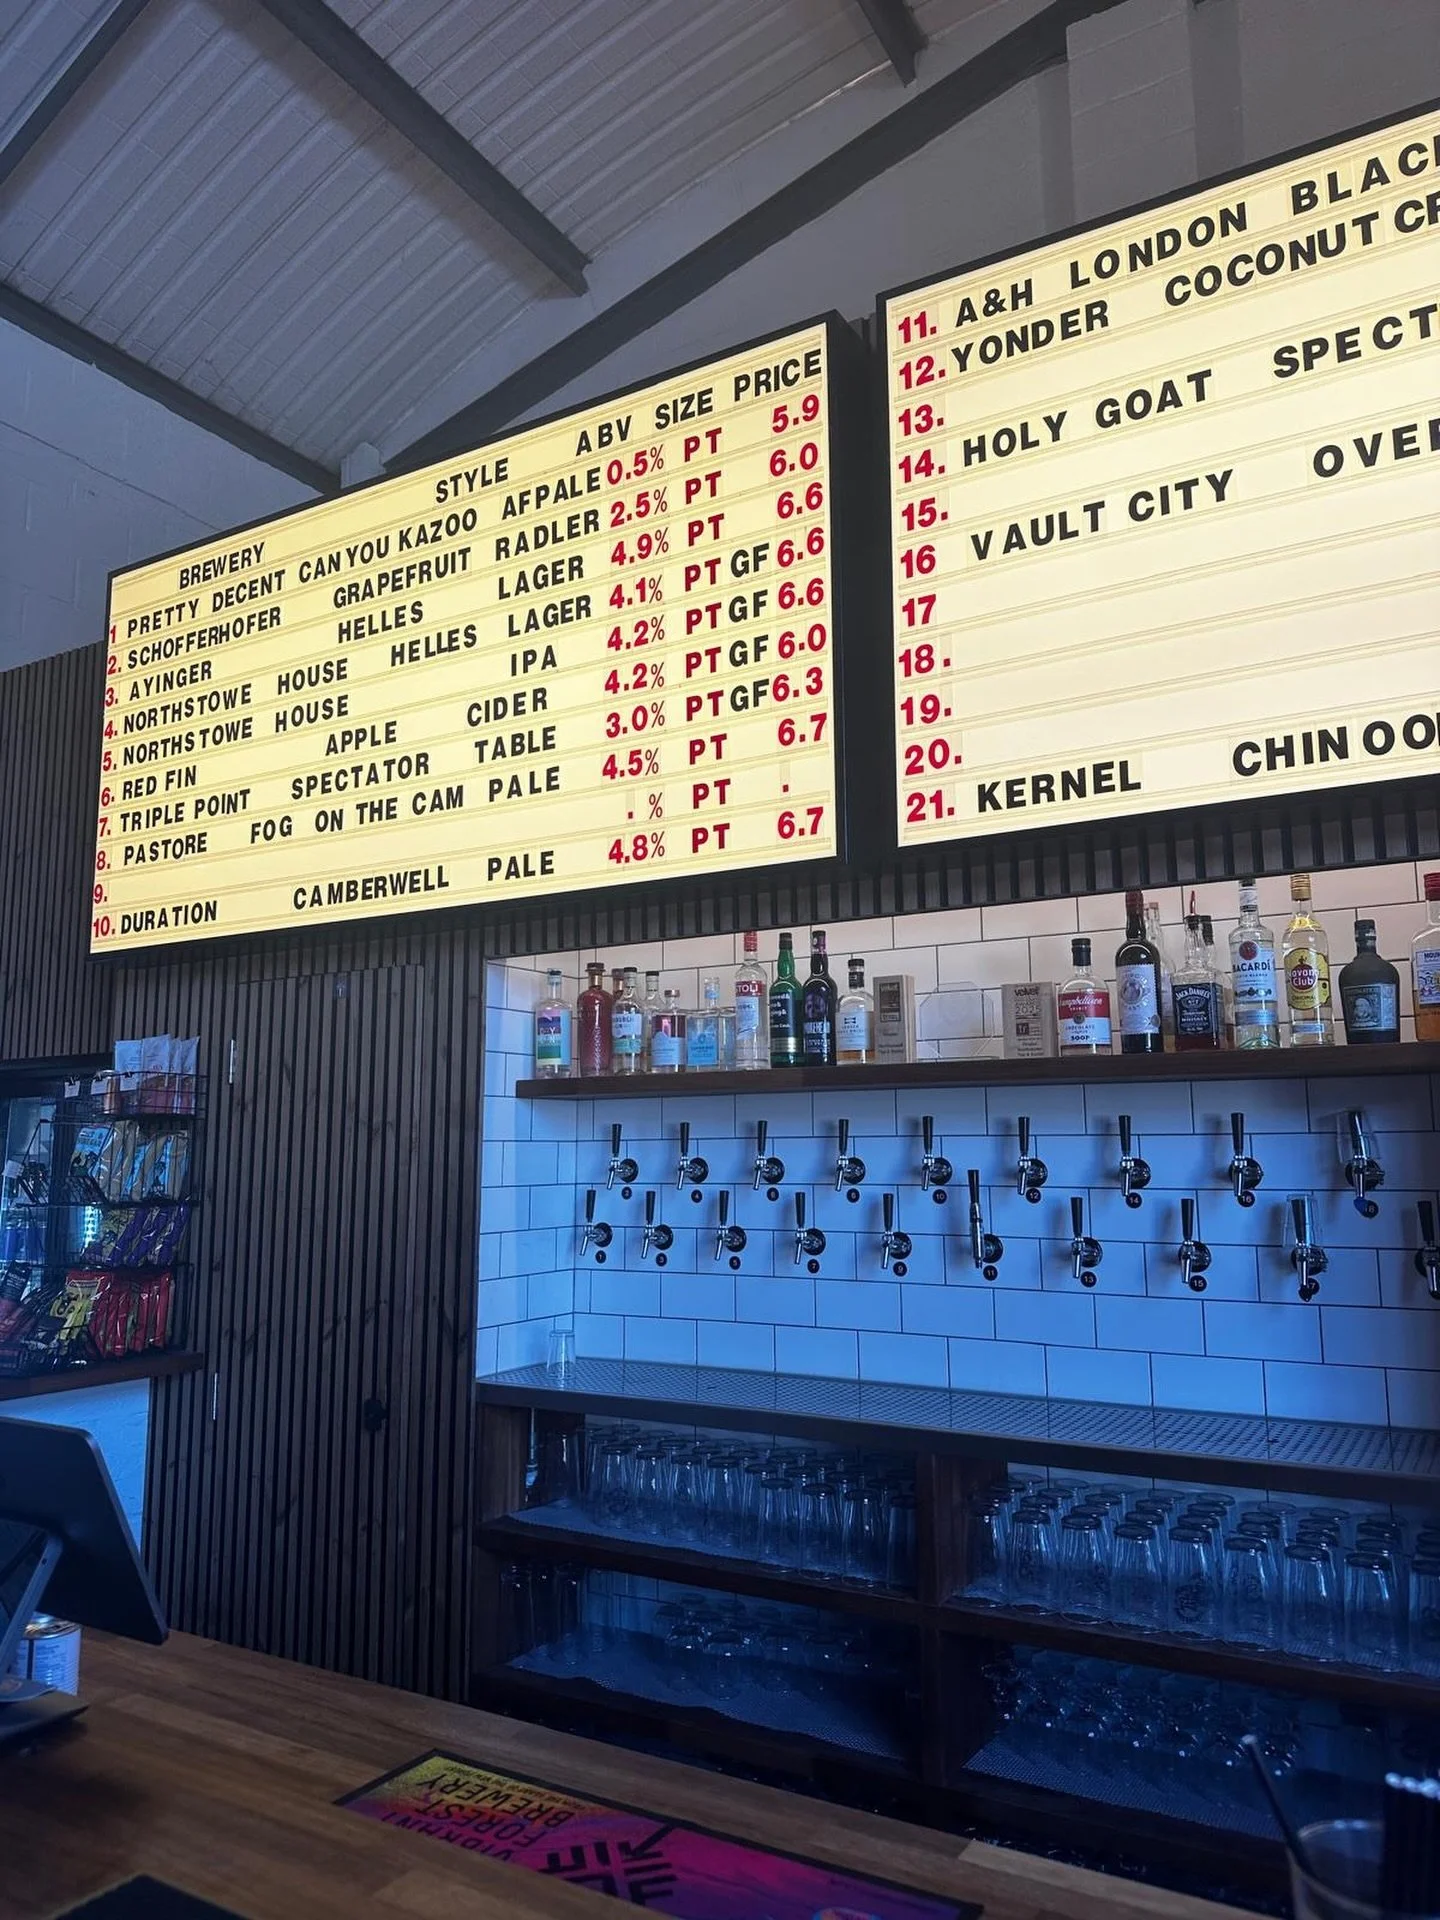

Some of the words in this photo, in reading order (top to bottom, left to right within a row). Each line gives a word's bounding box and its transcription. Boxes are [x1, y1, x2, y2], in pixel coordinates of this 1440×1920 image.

[897, 310, 937, 344] 11.
[955, 278, 1033, 328] A&H
[1069, 201, 1248, 290] LONDON
[1290, 134, 1440, 216] BLAC
[898, 355, 946, 390] 12.
[950, 299, 1109, 373] YONDER
[1164, 210, 1380, 307] COCONUT
[898, 448, 946, 484] 14.
[963, 410, 1068, 468] HOLY
[1095, 368, 1212, 429] GOAT
[1273, 303, 1440, 379] SPECT
[898, 403, 944, 437] 13.
[127, 598, 200, 639] PRETTY
[212, 568, 286, 613] DECENT
[398, 508, 478, 552] KAZOO
[606, 444, 664, 486] 0.5%
[684, 426, 722, 463] PT
[772, 394, 820, 434] 5.9
[179, 541, 265, 590] BREWERY
[435, 457, 509, 504] STYLE
[575, 414, 632, 457] ABV
[654, 387, 713, 430] SIZE
[734, 348, 822, 403] PRICE
[900, 544, 936, 579] 16
[970, 500, 1106, 561] VAULT
[1128, 468, 1233, 522] CITY
[901, 496, 949, 532] 15.
[105, 686, 120, 709] 3.
[129, 660, 212, 702] AYINGER
[338, 600, 424, 644] HELLES
[498, 555, 584, 601] LAGER
[610, 527, 669, 566] 4.9%
[687, 512, 725, 547] PT
[776, 481, 824, 520] 6.6
[107, 655, 123, 676] 2.
[127, 606, 281, 670] SCHOFFERHOFER
[333, 546, 471, 609] GRAPEFRUIT
[495, 508, 600, 562] RADLER
[610, 486, 668, 528] 2.5%
[685, 470, 722, 505] PT
[769, 442, 819, 477] 6.0
[901, 593, 937, 628] 17
[102, 750, 118, 773] 5.
[123, 716, 253, 767] NORTHSTOWE
[275, 694, 349, 733] HOUSE
[511, 644, 557, 677] IPA
[607, 614, 665, 652] 4.2%
[686, 601, 722, 636] PT
[728, 589, 768, 623] GF
[777, 577, 825, 610] 6.6
[104, 720, 118, 740] 4.
[123, 683, 252, 735] NORTHSTOWE
[277, 657, 348, 696] HOUSE
[390, 624, 477, 667] HELLES
[508, 594, 591, 638] LAGER
[609, 575, 663, 609] 4.1%
[684, 557, 722, 593] PT
[730, 542, 770, 578] GF
[776, 526, 825, 568] 6.6
[898, 643, 951, 678] 18.
[99, 816, 112, 838] 7.
[120, 801, 185, 833] TRIPLE
[194, 788, 251, 820] POINT
[291, 752, 429, 800] SPECTATOR
[474, 725, 556, 764] TABLE
[605, 700, 665, 739] 3.0%
[686, 689, 724, 722] PT
[730, 678, 770, 712] GF
[772, 666, 823, 703] 6.3
[100, 786, 116, 808] 6.
[122, 775, 157, 801] RED
[165, 764, 197, 792] FIN
[325, 720, 397, 757] APPLE
[467, 687, 548, 727] CIDER
[604, 662, 665, 695] 4.2%
[685, 646, 722, 679] PT
[729, 634, 769, 668] GF
[777, 623, 827, 660] 6.0
[900, 693, 952, 726] 19.
[904, 738, 962, 776] 20.
[96, 850, 112, 872] 8.
[123, 831, 208, 866] PASTORE
[250, 815, 293, 844] FOG
[314, 808, 344, 833] ON
[355, 796, 398, 825] THE
[412, 784, 464, 816] CAM
[488, 765, 560, 803] PALE
[602, 747, 659, 780] 4.5%
[689, 732, 728, 766] PT
[777, 712, 828, 747] 6.7
[906, 789, 955, 823] 21.
[977, 760, 1142, 813] KERNEL
[1232, 712, 1440, 777] CHINOO
[93, 915, 116, 938] 10.
[120, 900, 218, 935] DURATION
[293, 865, 450, 910] CAMBERWELL
[487, 850, 555, 882] PALE
[608, 831, 665, 865] 4.8%
[691, 822, 731, 854] PT
[777, 806, 824, 840] 6.7
[95, 883, 109, 905] 9.
[692, 778, 731, 810] PT
[736, 984, 758, 994] TOLI
[1029, 1192, 1039, 1200] 12
[1129, 1197, 1139, 1205] 14
[1242, 1196, 1252, 1204] 16
[987, 1270, 994, 1278] 11
[1084, 1276, 1094, 1284] 13
[1193, 1279, 1204, 1288] 15
[415, 1799, 548, 1848] FOREST
[416, 1773, 575, 1829] BREWERY
